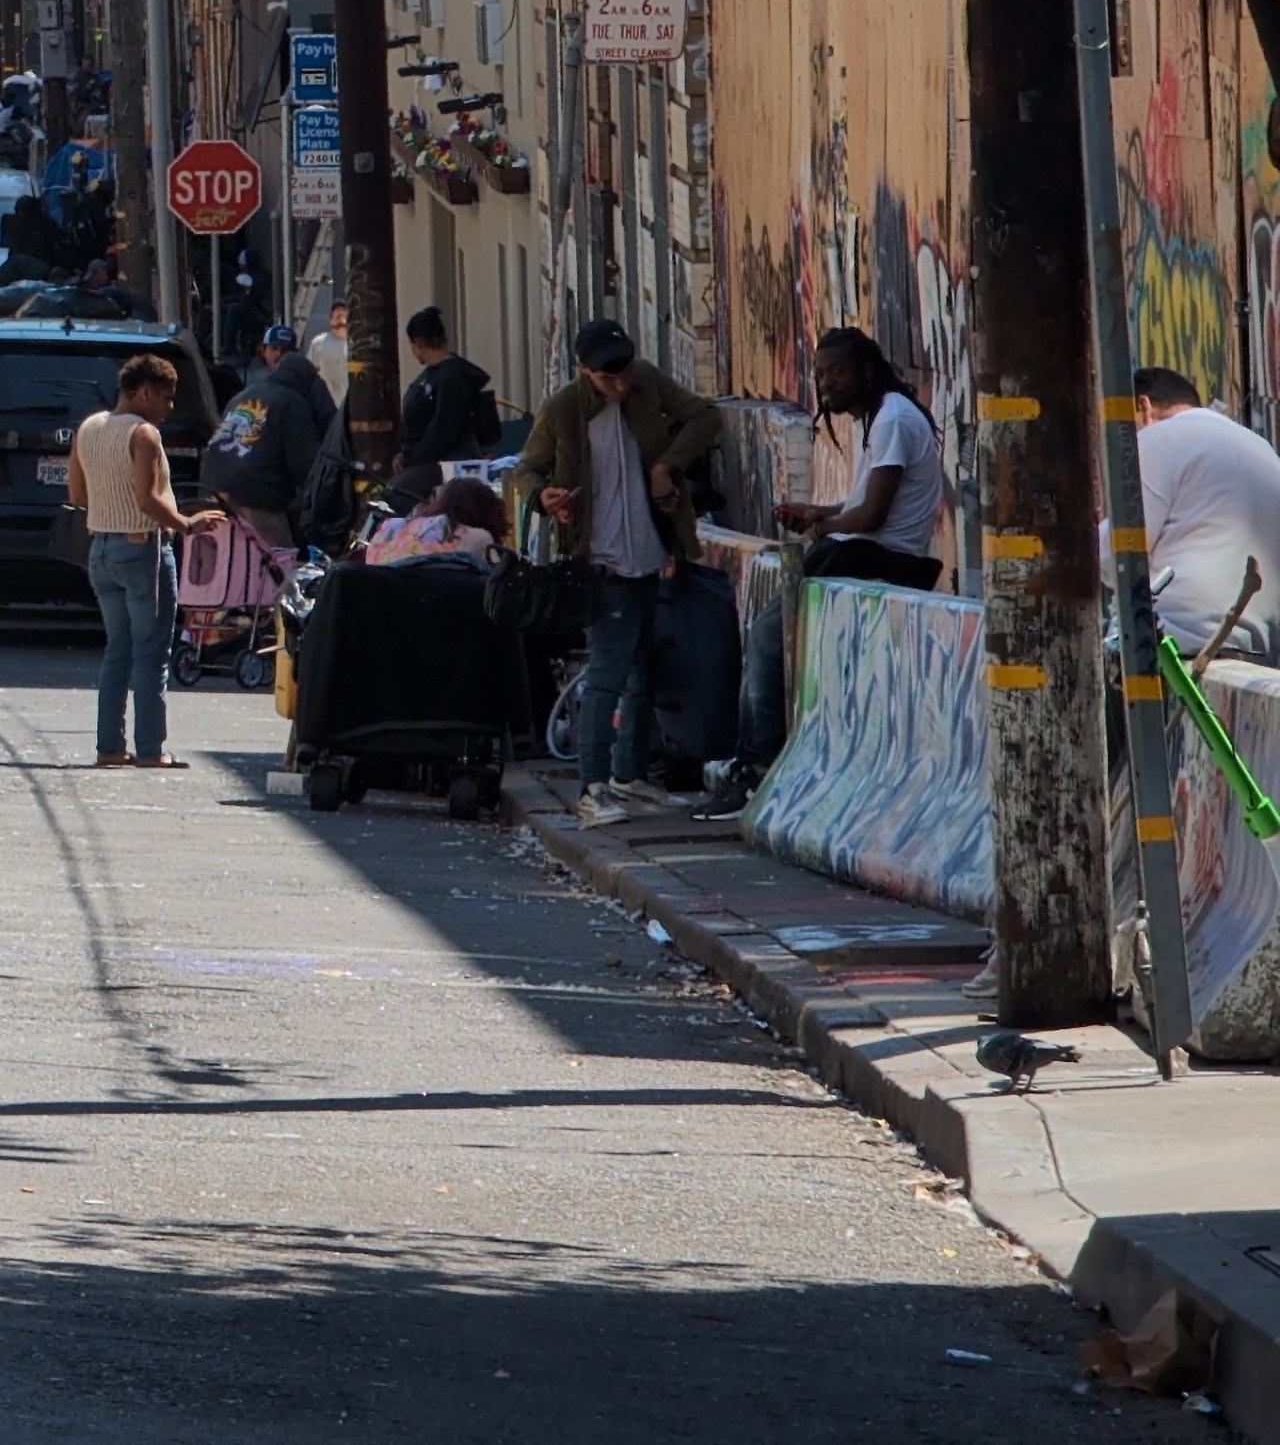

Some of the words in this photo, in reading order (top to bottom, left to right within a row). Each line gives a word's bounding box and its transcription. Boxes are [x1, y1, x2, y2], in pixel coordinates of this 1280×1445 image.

[297, 43, 322, 58] Pay
[595, 48, 627, 58] STREET
[630, 48, 672, 59] CLEANING
[299, 114, 321, 127] Pay
[299, 127, 340, 138] Licens
[299, 139, 331, 149] Plate
[175, 169, 254, 205] STOP
